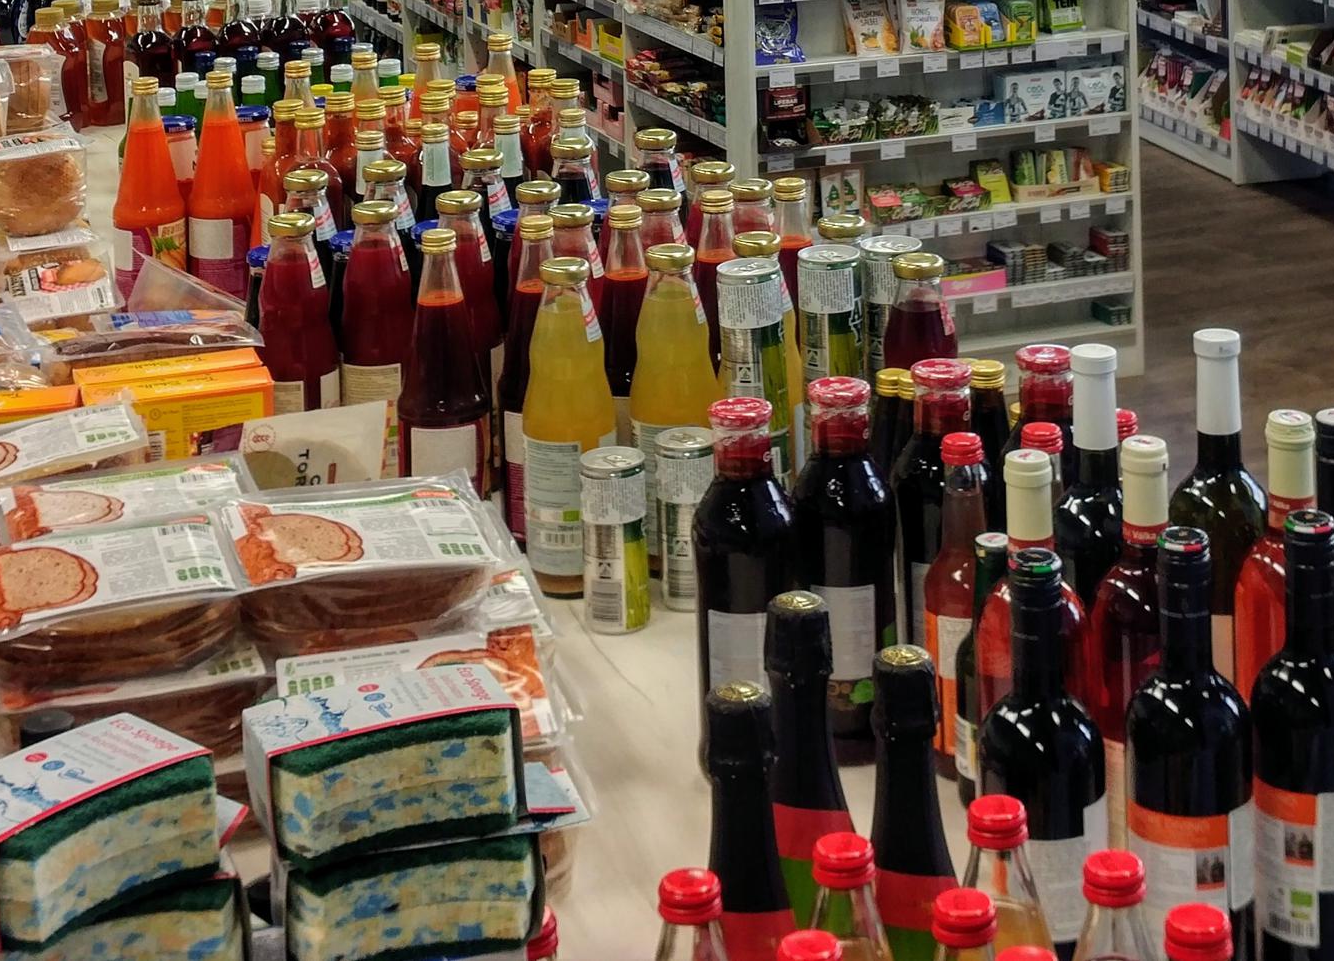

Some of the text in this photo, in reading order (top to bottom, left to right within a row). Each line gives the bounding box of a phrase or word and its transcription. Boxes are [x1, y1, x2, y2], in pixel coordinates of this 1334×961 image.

[773, 98, 798, 106] LIFEBAR
[457, 666, 492, 702] Eco Sponge
[109, 718, 134, 732] Eco
[133, 726, 180, 753] Sponge
